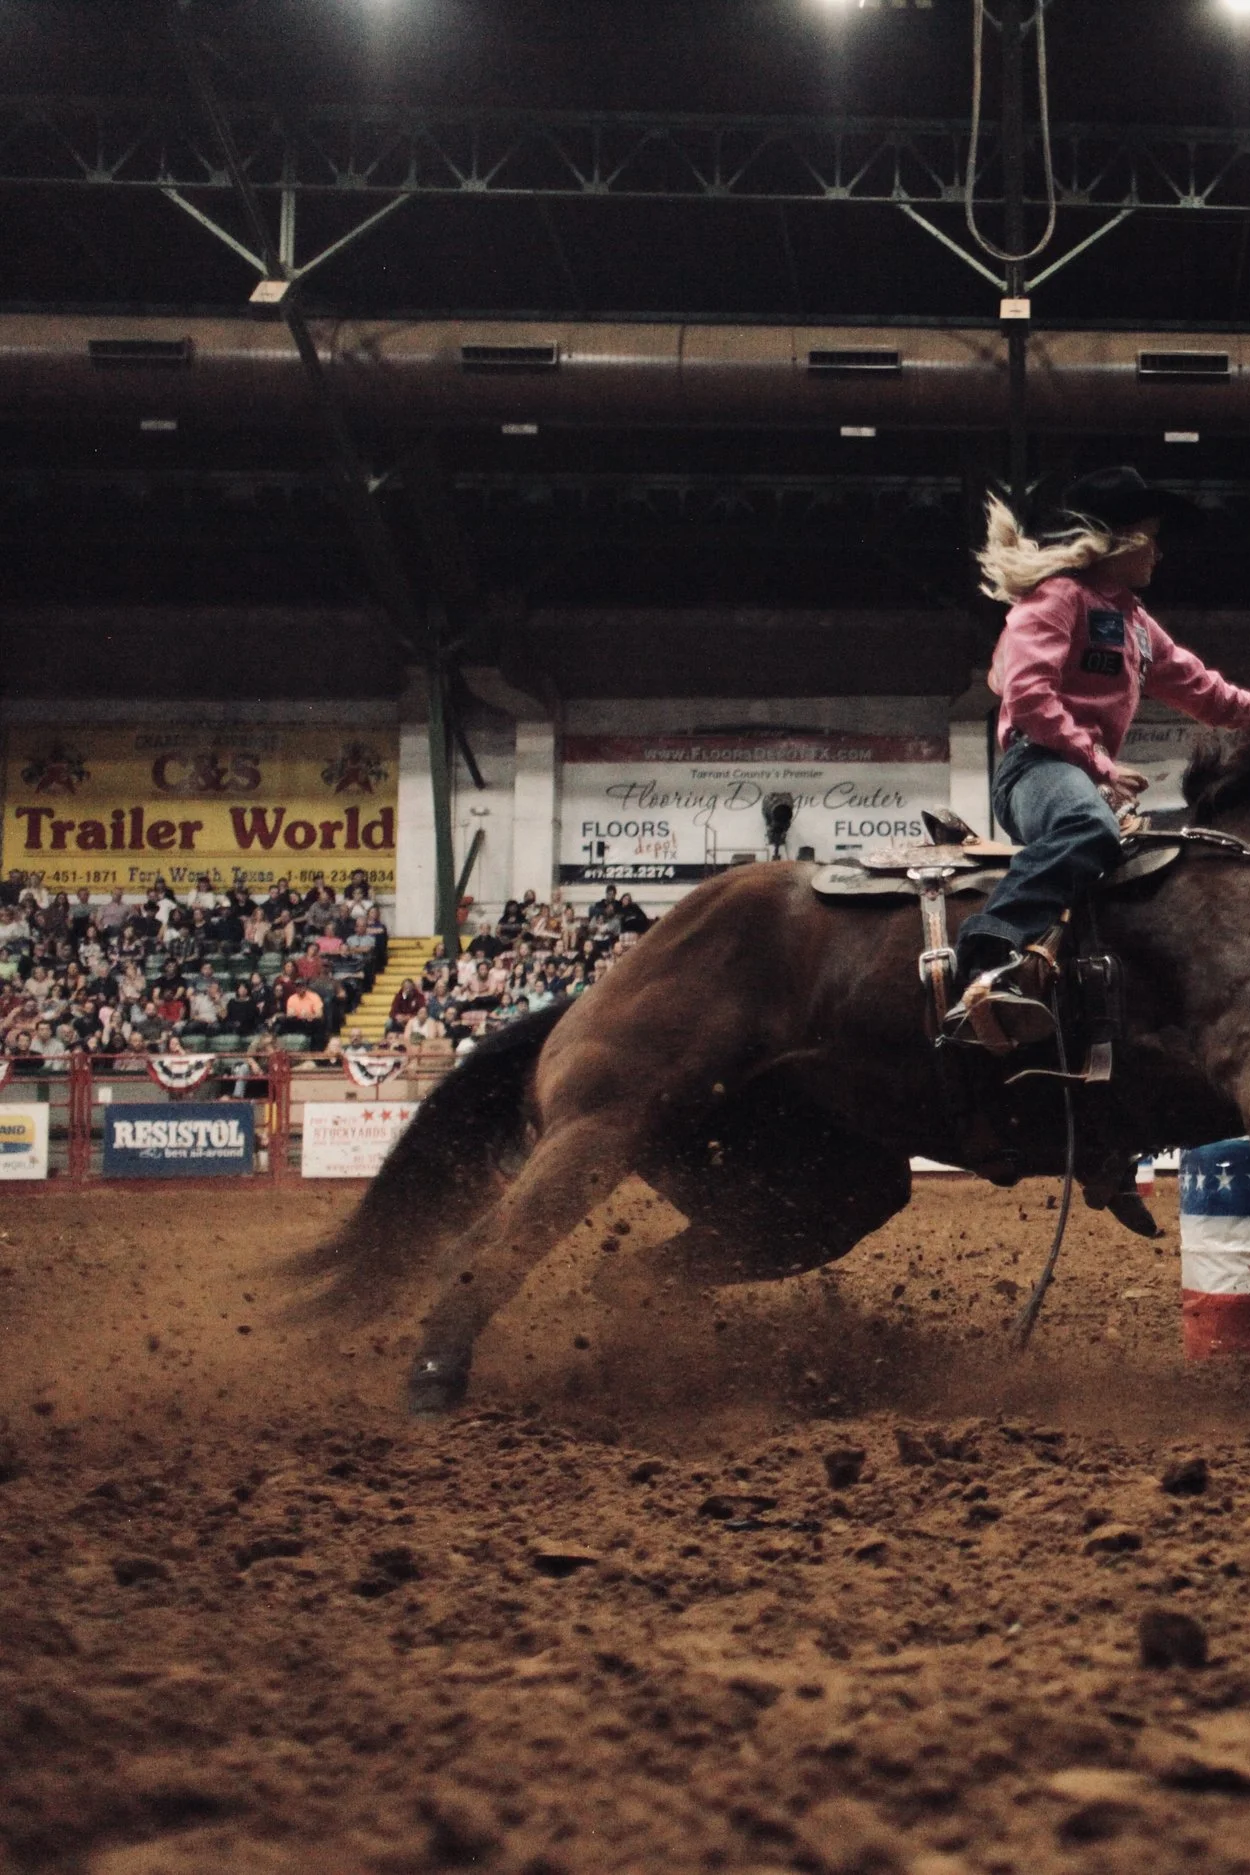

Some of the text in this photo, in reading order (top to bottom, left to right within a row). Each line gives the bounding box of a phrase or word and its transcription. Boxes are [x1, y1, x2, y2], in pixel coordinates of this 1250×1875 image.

[1126, 727, 1169, 744] fficial
[152, 752, 262, 791] C&S
[691, 769, 730, 779] Tarrant
[782, 769, 824, 779] Premier
[606, 779, 718, 826] Flooring
[823, 781, 908, 809] Center
[15, 806, 396, 850] Trailer World
[582, 820, 670, 838] FLOORS
[834, 819, 922, 837] FLOORS
[634, 832, 678, 859] depot
[113, 1120, 244, 1149] RESISTOL
